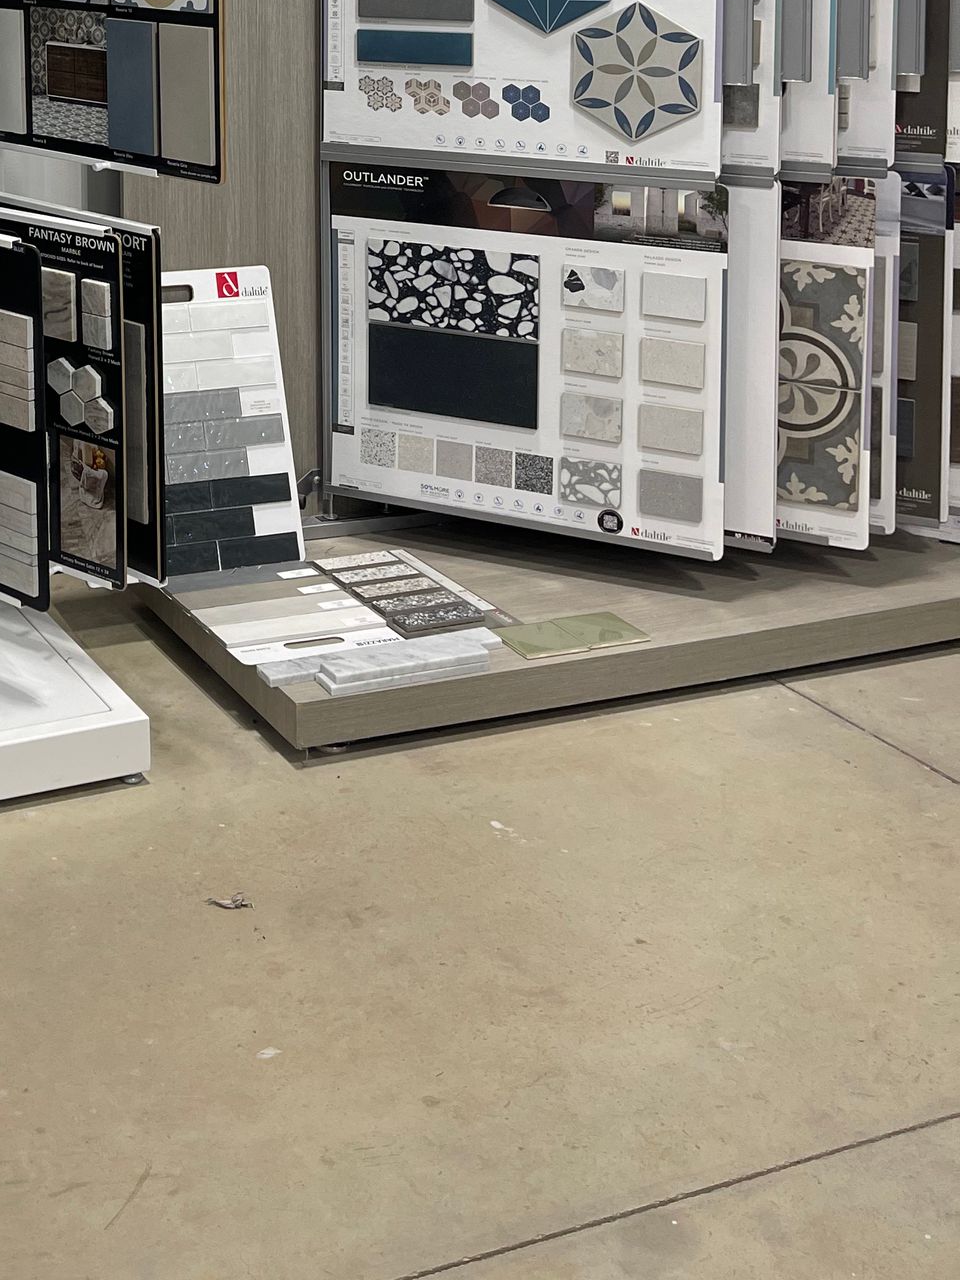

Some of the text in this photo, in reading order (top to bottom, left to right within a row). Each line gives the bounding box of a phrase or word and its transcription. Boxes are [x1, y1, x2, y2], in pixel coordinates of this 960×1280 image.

[903, 124, 937, 136] daltile
[28, 226, 115, 254] FANTASY BROWN
[61, 246, 81, 257] MARBLE
[898, 486, 932, 500] daltile
[781, 519, 814, 532] daltile
[640, 528, 673, 542] daltile
